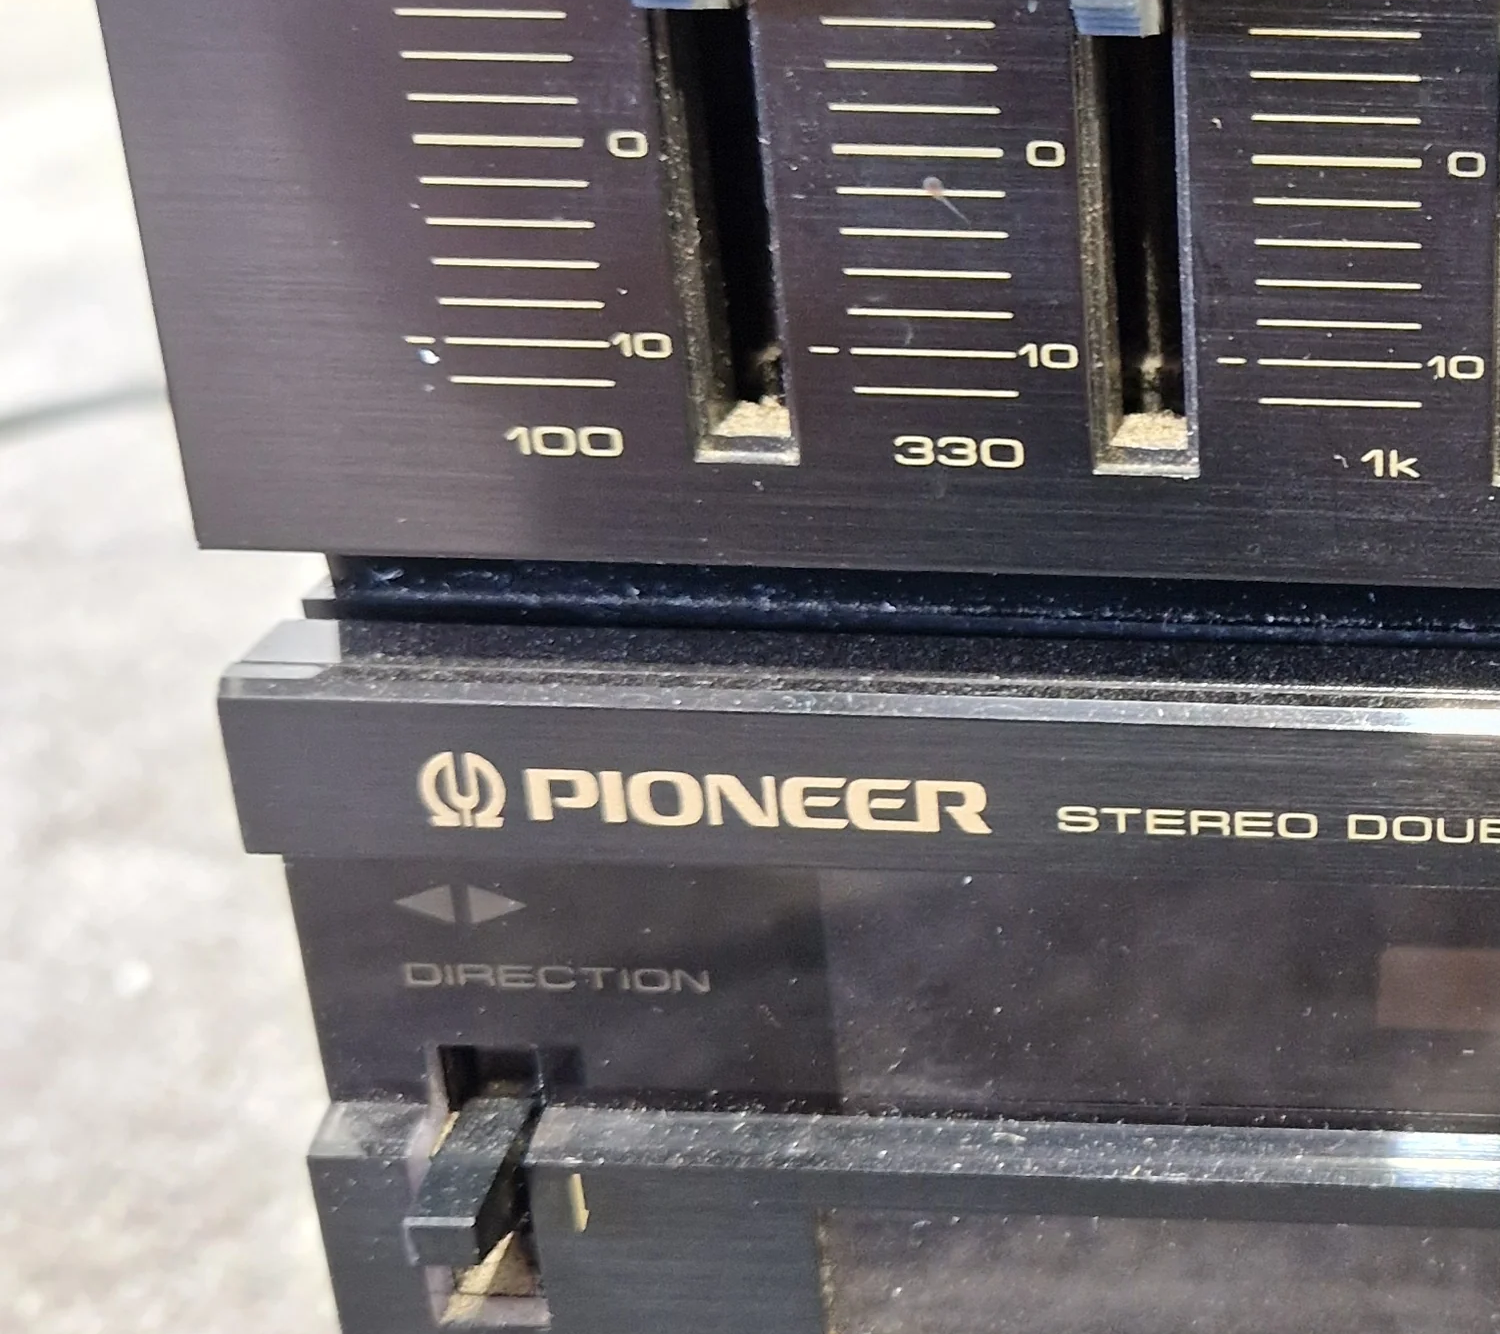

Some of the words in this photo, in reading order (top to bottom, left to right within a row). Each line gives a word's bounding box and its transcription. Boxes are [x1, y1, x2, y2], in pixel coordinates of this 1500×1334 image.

[607, 129, 649, 158] 0
[1025, 140, 1066, 168] 0
[1447, 150, 1486, 178] 0
[610, 332, 673, 359] 10
[1017, 343, 1079, 369] 10
[1426, 355, 1485, 380] 10
[504, 425, 624, 457] 100
[893, 435, 1025, 468] 330
[1360, 448, 1420, 478] 1k
[523, 768, 992, 835] PIONEER
[1056, 805, 1319, 840] STEREO
[398, 961, 711, 993] DIRECTION
